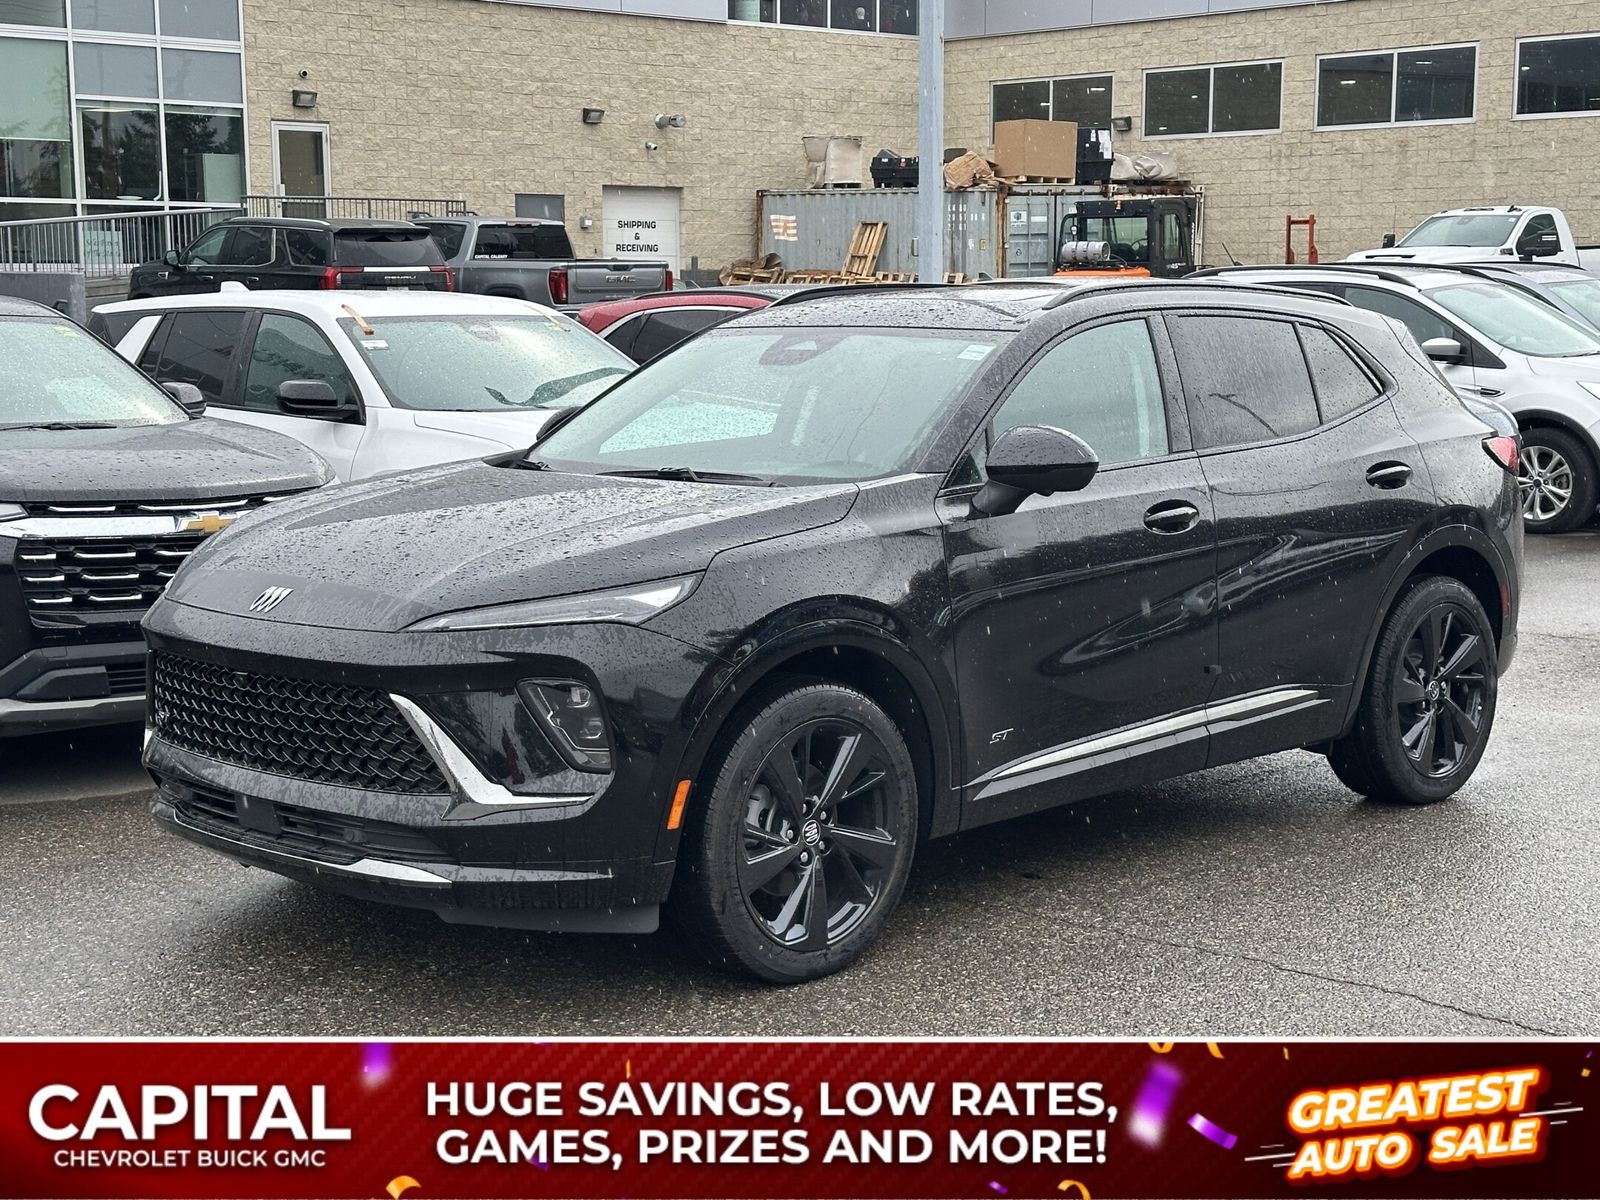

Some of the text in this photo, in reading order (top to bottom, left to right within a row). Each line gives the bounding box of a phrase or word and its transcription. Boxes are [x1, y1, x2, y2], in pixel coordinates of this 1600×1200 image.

[617, 220, 657, 229] SHIPPING
[634, 232, 641, 241] &
[615, 243, 659, 253] RECEIVING
[989, 728, 1014, 744] ST
